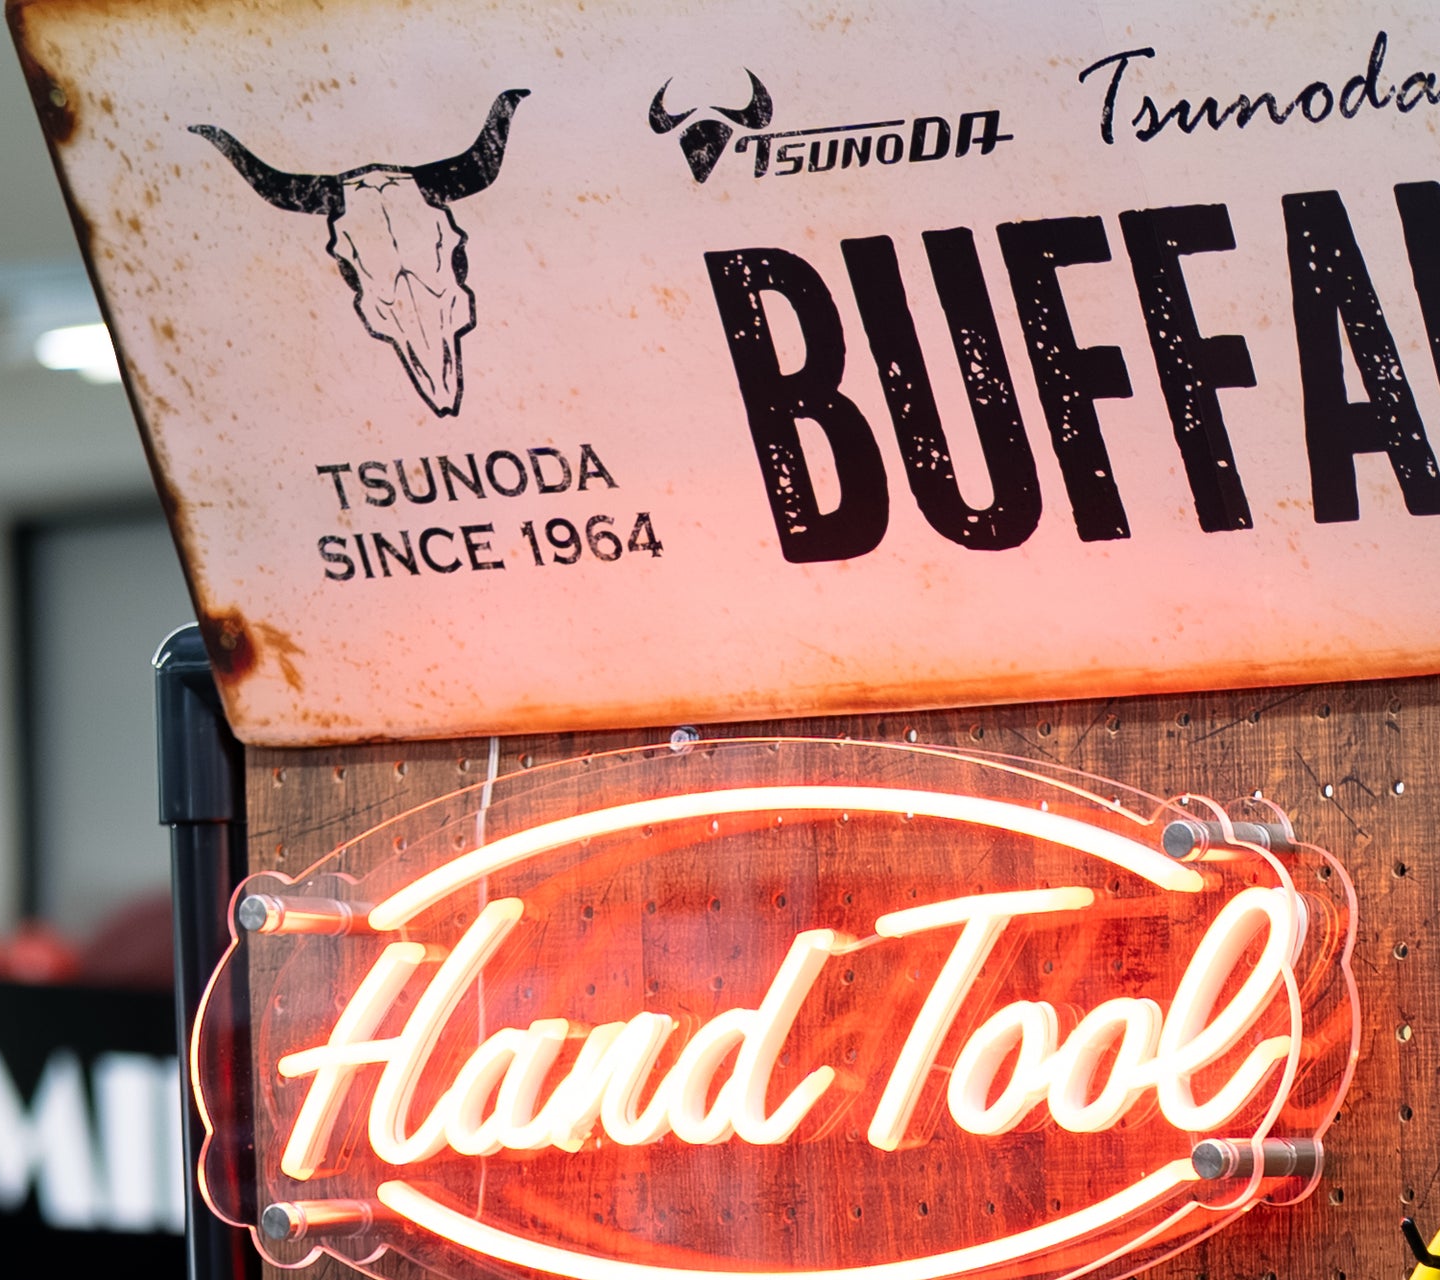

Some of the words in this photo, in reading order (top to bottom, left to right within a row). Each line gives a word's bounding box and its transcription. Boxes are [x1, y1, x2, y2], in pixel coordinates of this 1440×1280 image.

[315, 442, 620, 512] TSUNODA
[315, 523, 507, 584] SINCE
[518, 511, 665, 572] 1964
[277, 895, 835, 1183] Hand
[866, 883, 1300, 1153] Tool
